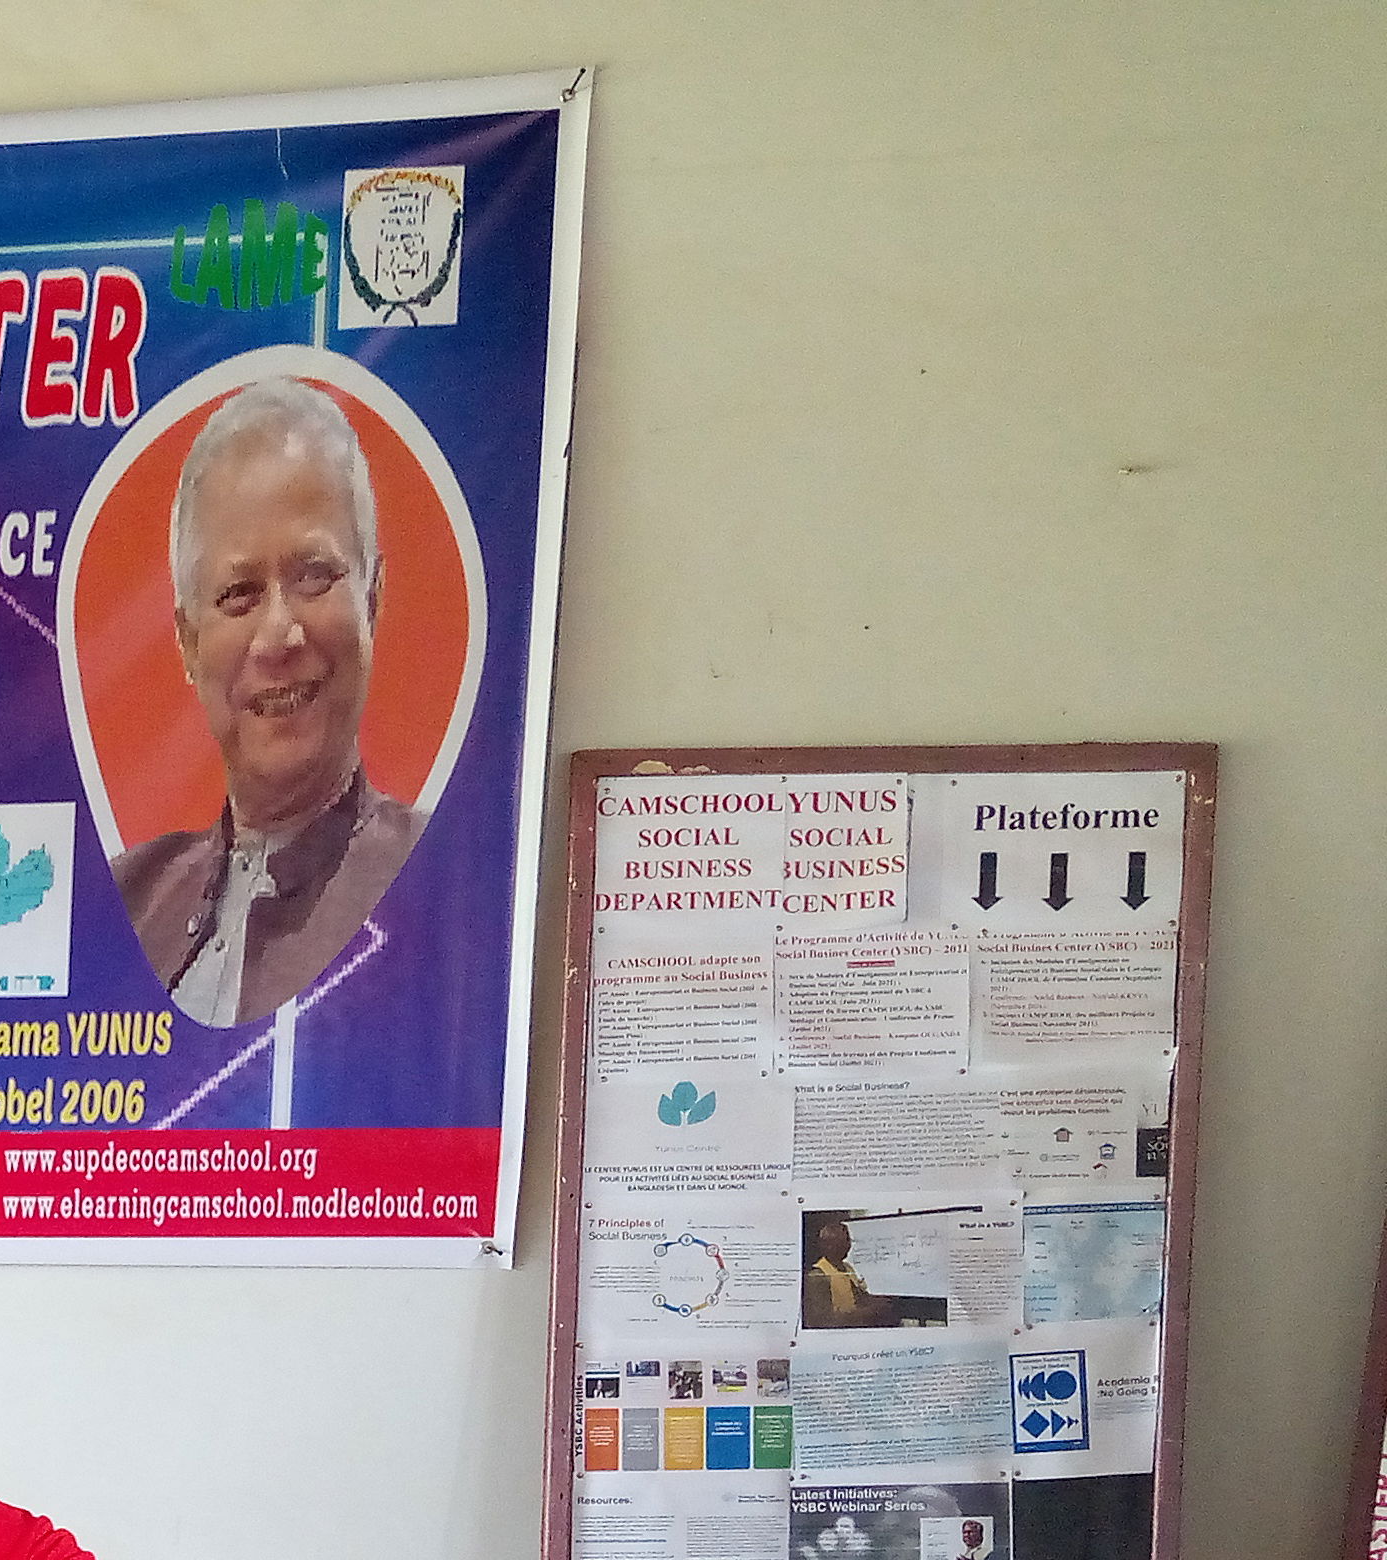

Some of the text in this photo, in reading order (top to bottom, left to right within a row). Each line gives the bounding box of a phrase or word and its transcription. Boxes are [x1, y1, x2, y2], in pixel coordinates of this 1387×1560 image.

[597, 791, 783, 817] CAMSCHOOL
[788, 789, 898, 814] YUNUS
[974, 802, 1160, 832] Plateforme
[638, 826, 740, 848] SOCIAL
[789, 826, 893, 848] SOCIAL
[624, 858, 752, 880] BUSINESS
[595, 889, 783, 912] DEPARTMENT
[782, 889, 898, 914] CENTER
[776, 936, 788, 945] Le
[791, 934, 852, 946] Programme
[1055, 942, 1091, 951] Center
[1151, 940, 1175, 950] 2021
[608, 955, 761, 969] CAMSCHOOL adapte son
[776, 951, 806, 959] Social
[851, 948, 887, 957] Center
[944, 944, 967, 954] 2021
[594, 975, 660, 987] programme
[681, 971, 715, 982] Social
[719, 970, 768, 980] Business
[66, 1010, 173, 1056] YUNUS
[835, 1084, 862, 1092] Social
[865, 1082, 910, 1091] Business?
[62, 1079, 148, 1125] 2006
[4, 1141, 318, 1181] www.supdecocamschool.org
[2, 1187, 478, 1226] www.elearningcamschool.modlecloud.com
[598, 1219, 652, 1229] Principles
[654, 1219, 664, 1227] of
[588, 1231, 667, 1240] Social Business
[1117, 1387, 1148, 1397] Going
[574, 1374, 583, 1457] YSBC Activities
[792, 1490, 831, 1500] Latest
[833, 1488, 898, 1499] Initiatives:
[791, 1501, 925, 1513] YSBC Webinar Series
